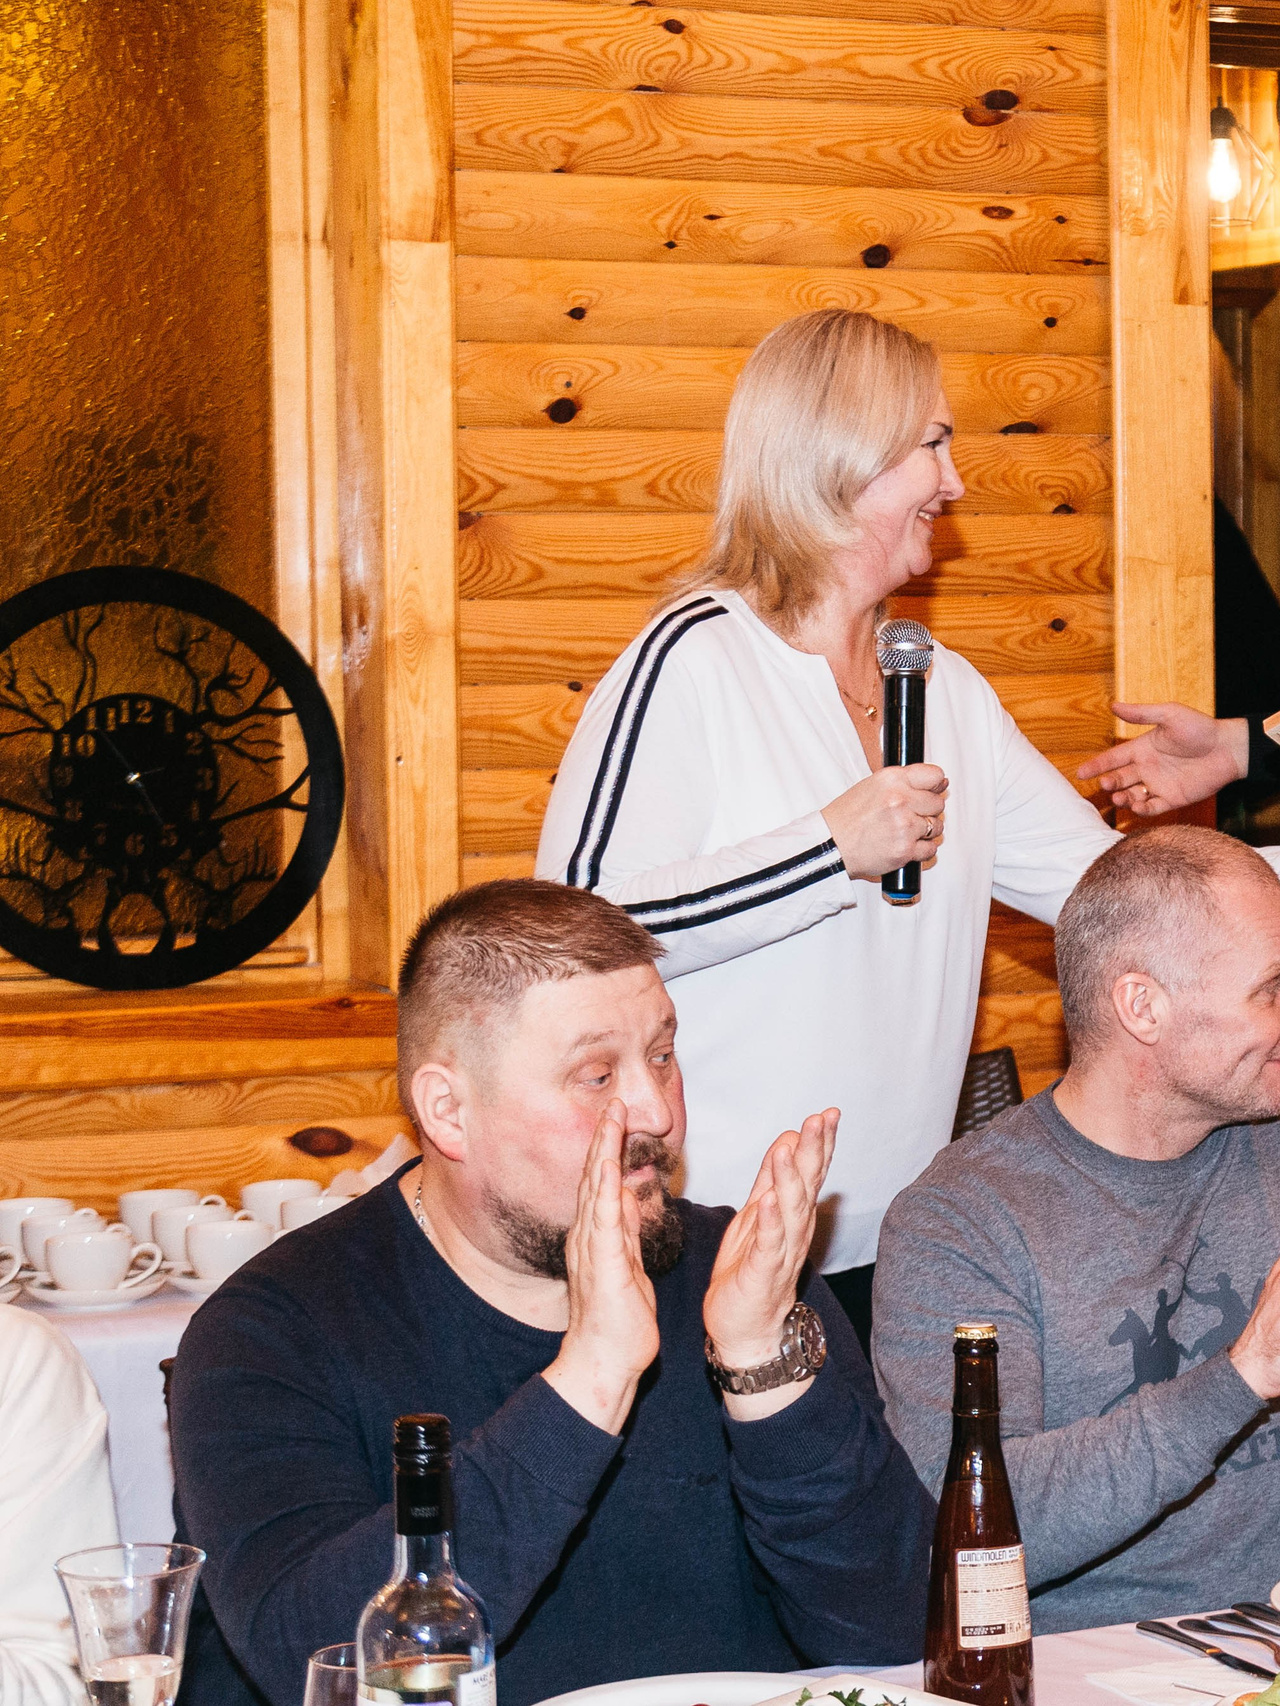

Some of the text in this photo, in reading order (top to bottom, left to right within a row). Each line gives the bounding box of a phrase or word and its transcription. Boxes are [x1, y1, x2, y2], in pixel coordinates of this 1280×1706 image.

[85, 707, 117, 732] 11
[119, 700, 153, 724] 12
[164, 709, 175, 734] 1
[61, 733, 97, 758] 10
[184, 731, 205, 756] 2
[196, 767, 214, 791] 3
[64, 799, 84, 823] 8
[125, 833, 145, 856] 6
[159, 823, 179, 847] 5
